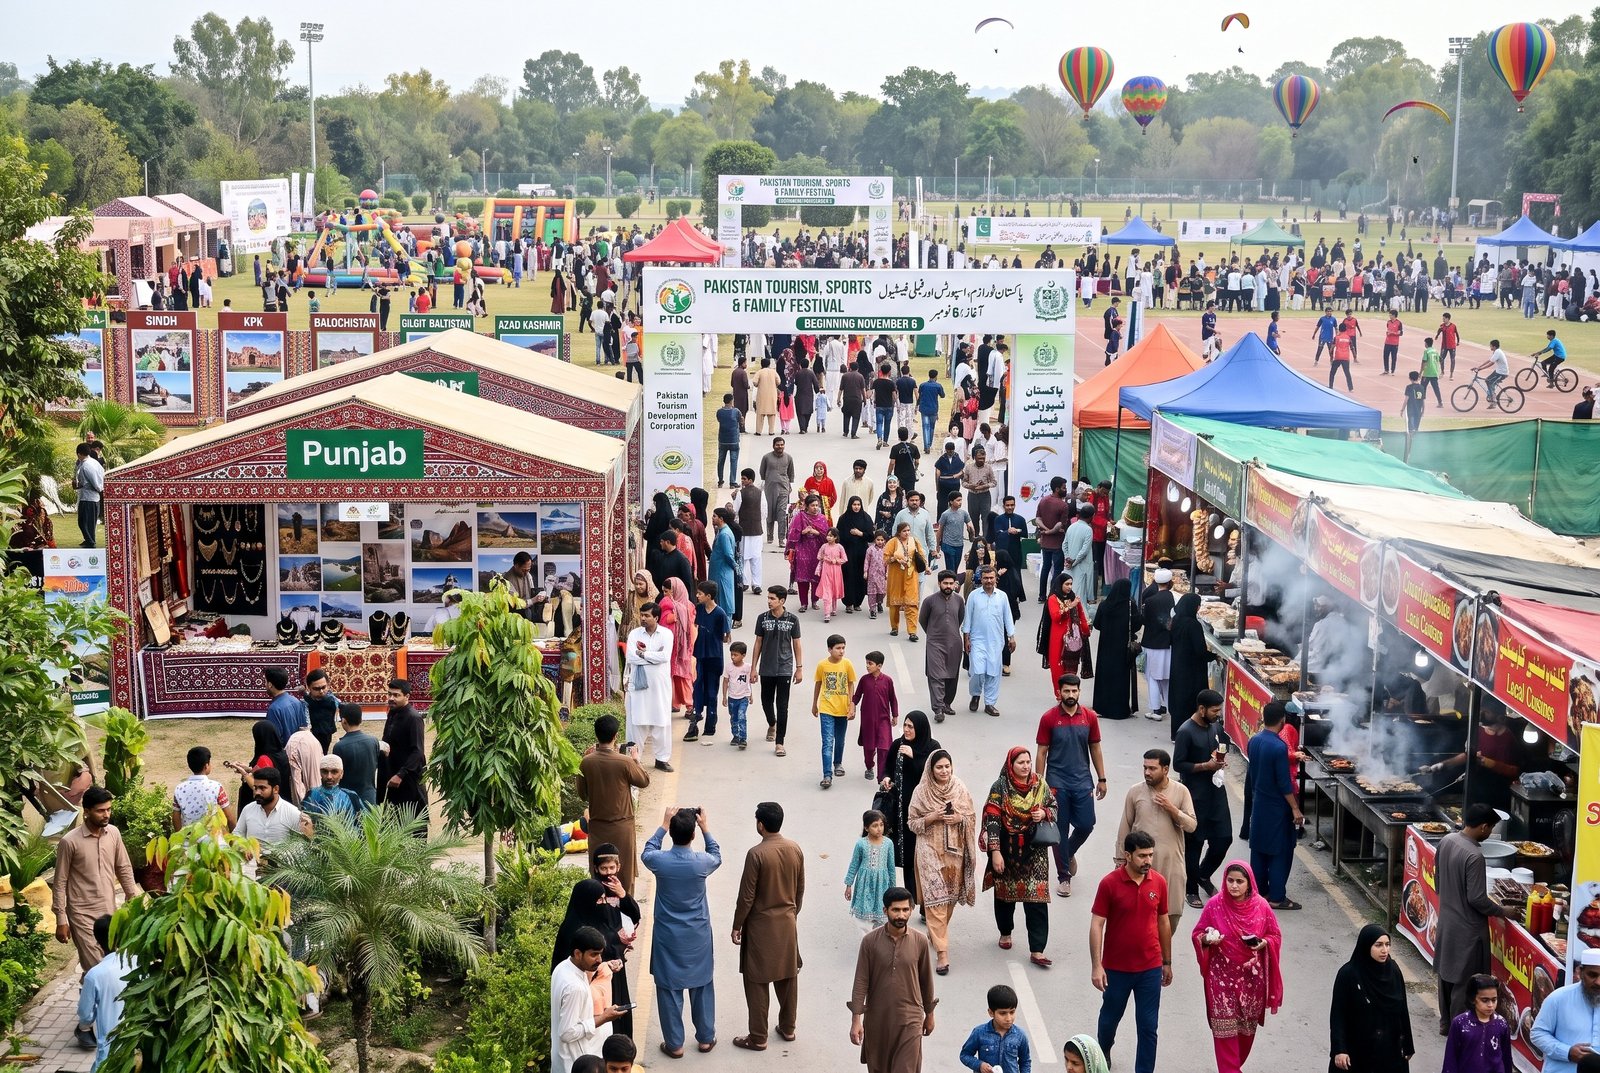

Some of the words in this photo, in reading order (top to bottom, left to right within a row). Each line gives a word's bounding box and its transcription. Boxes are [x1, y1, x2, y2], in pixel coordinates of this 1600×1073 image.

[760, 178, 791, 187] PAKISTAN
[825, 179, 851, 188] SPORTS
[780, 188, 804, 196] FAMILY
[805, 188, 836, 197] FESTIVAL
[704, 280, 762, 294] PAKISTAN
[766, 280, 822, 295] TOURISM,
[826, 280, 872, 294] SPORTS
[732, 298, 741, 313] &
[744, 298, 786, 312] FAMILY
[790, 298, 845, 313] FESTIVAL
[952, 307, 960, 318] 6
[145, 315, 178, 327] SINDH
[243, 316, 264, 327] KPK
[314, 317, 376, 328] BALOCHISTAN
[401, 318, 427, 328] GILGIT
[429, 319, 471, 328] BALTISTAN
[498, 320, 521, 330] AZAD
[523, 320, 561, 330] KASHMIR
[659, 315, 692, 324] PTDC
[804, 318, 855, 329] BEGINNING
[857, 319, 907, 329] NOVEMBER
[911, 319, 918, 329] 6
[656, 391, 688, 399] Pakistan
[657, 401, 688, 409] Tourism
[647, 411, 698, 421] Development
[650, 421, 695, 432] Corporation
[303, 440, 407, 473] Punjab
